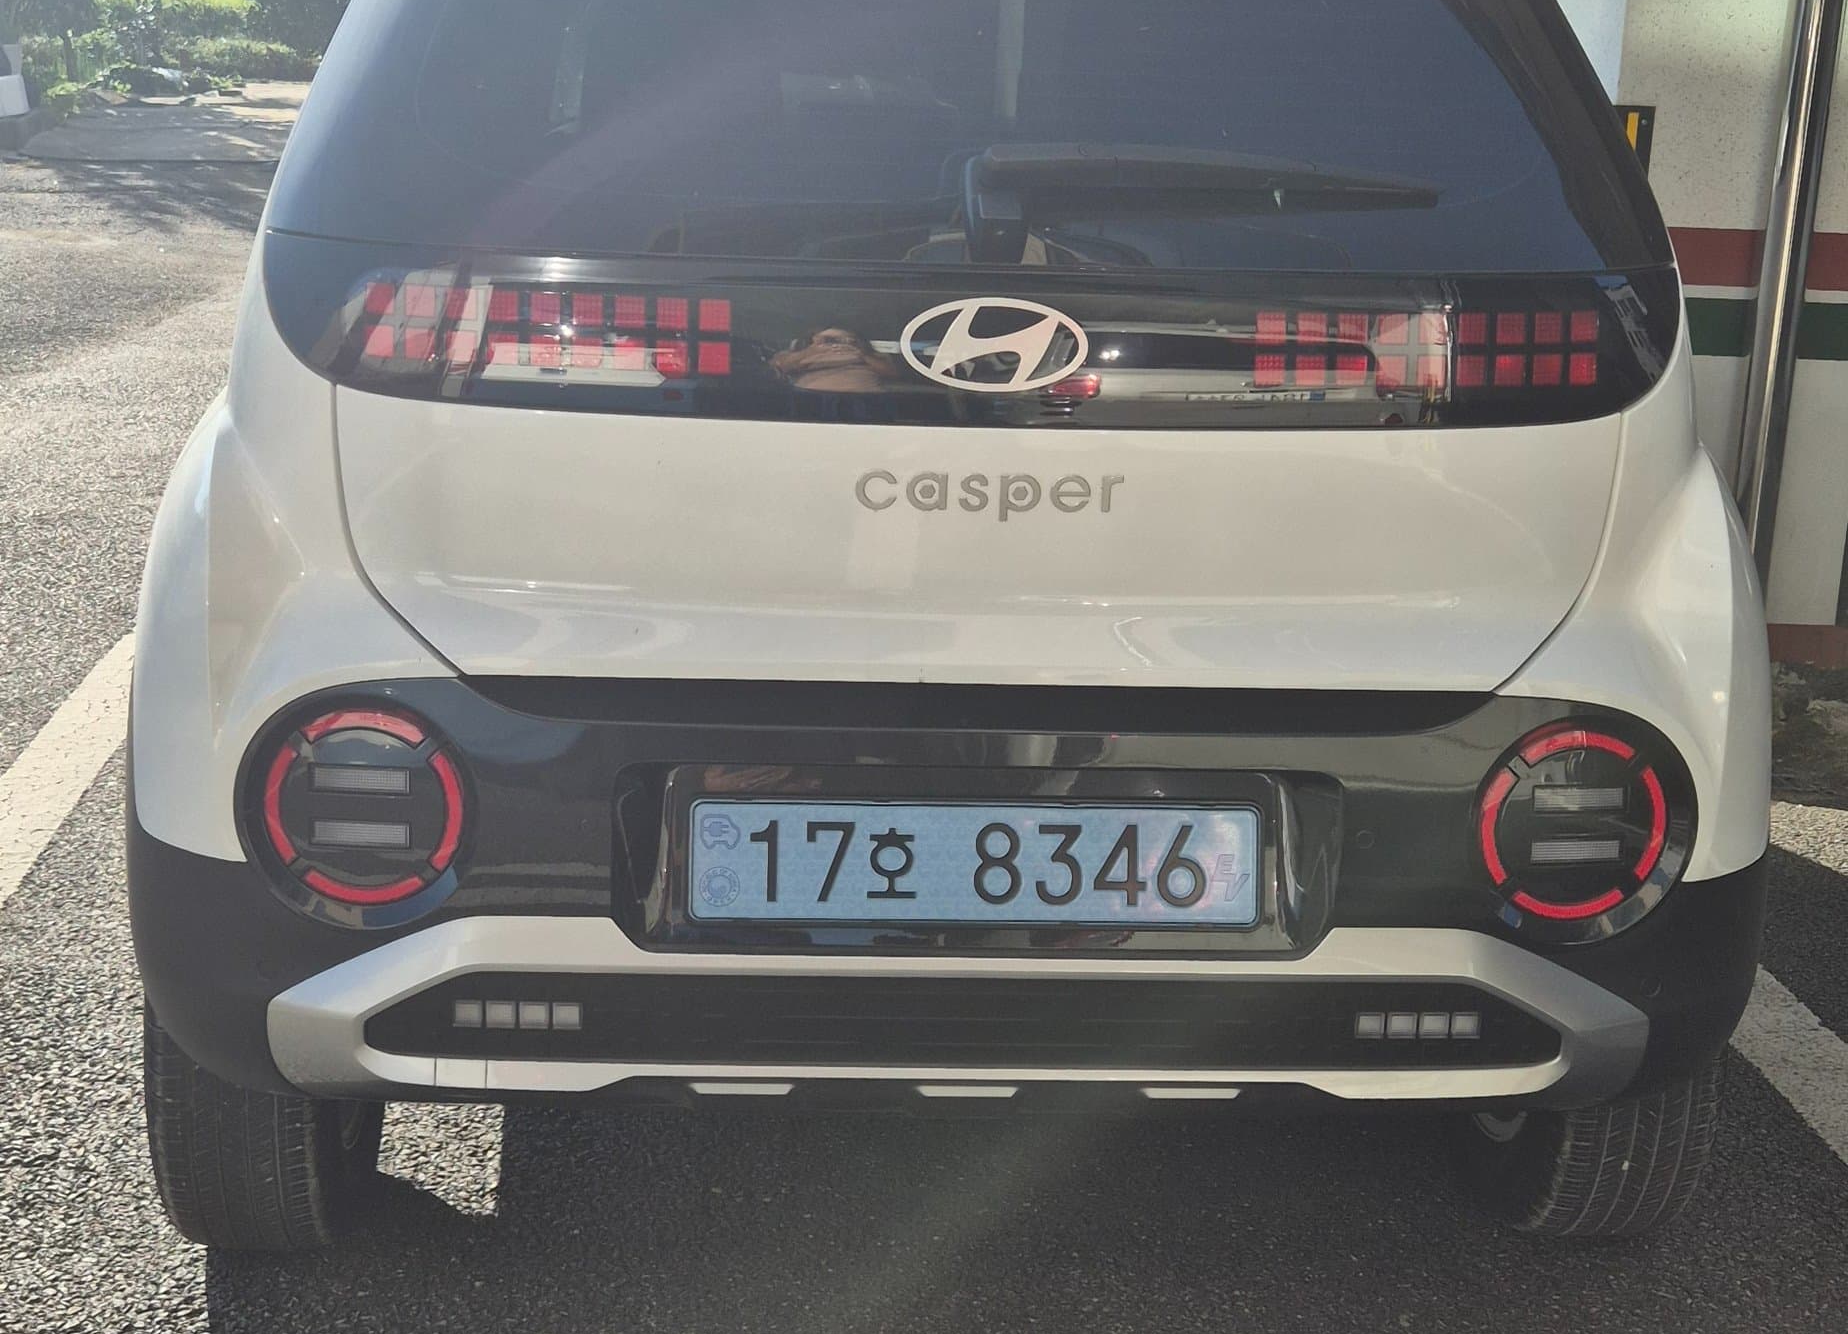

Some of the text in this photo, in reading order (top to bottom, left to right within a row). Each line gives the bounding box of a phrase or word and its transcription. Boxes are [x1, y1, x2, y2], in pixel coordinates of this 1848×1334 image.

[855, 470, 1124, 522] casper
[750, 819, 917, 902] 17호
[973, 822, 1207, 907] 8346
[1211, 853, 1251, 902] EV
